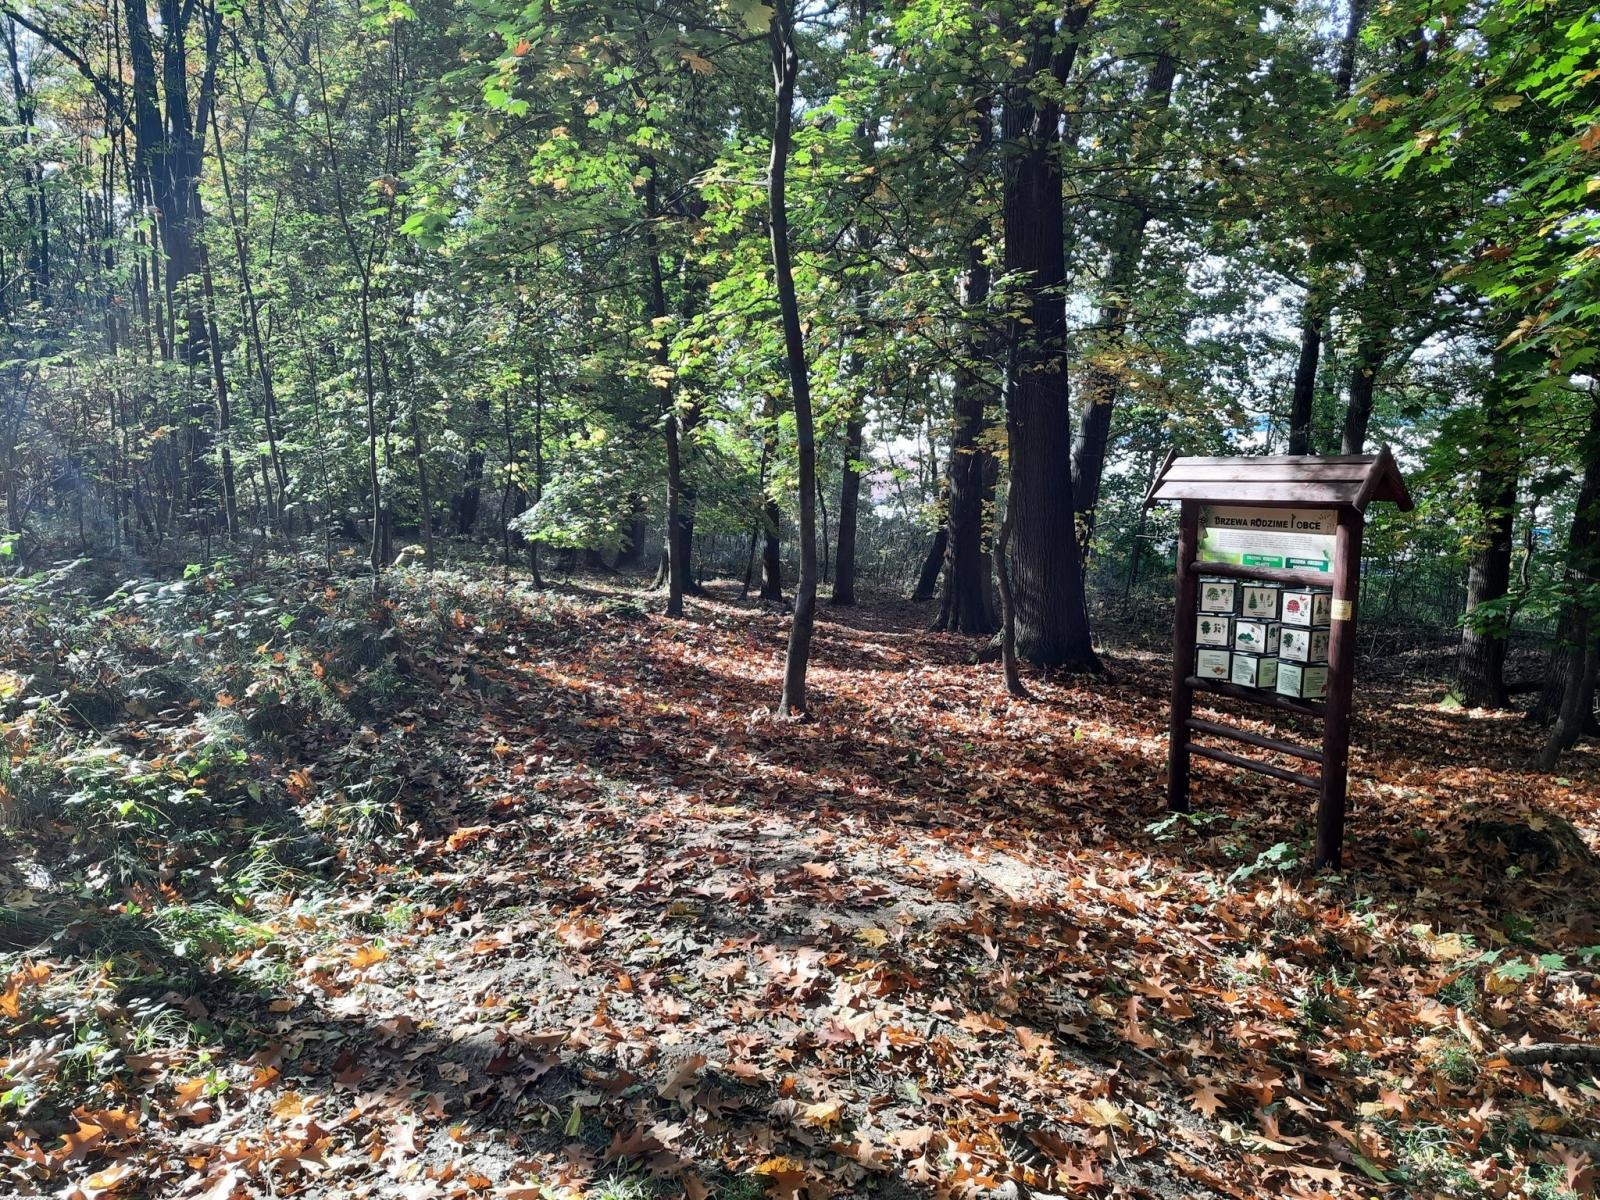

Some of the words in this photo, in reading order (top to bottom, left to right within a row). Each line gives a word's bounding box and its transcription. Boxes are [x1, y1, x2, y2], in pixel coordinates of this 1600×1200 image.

[1215, 516, 1248, 526] DRZEWA
[1250, 518, 1288, 528] RODZIME
[1296, 520, 1321, 530] OBCE
